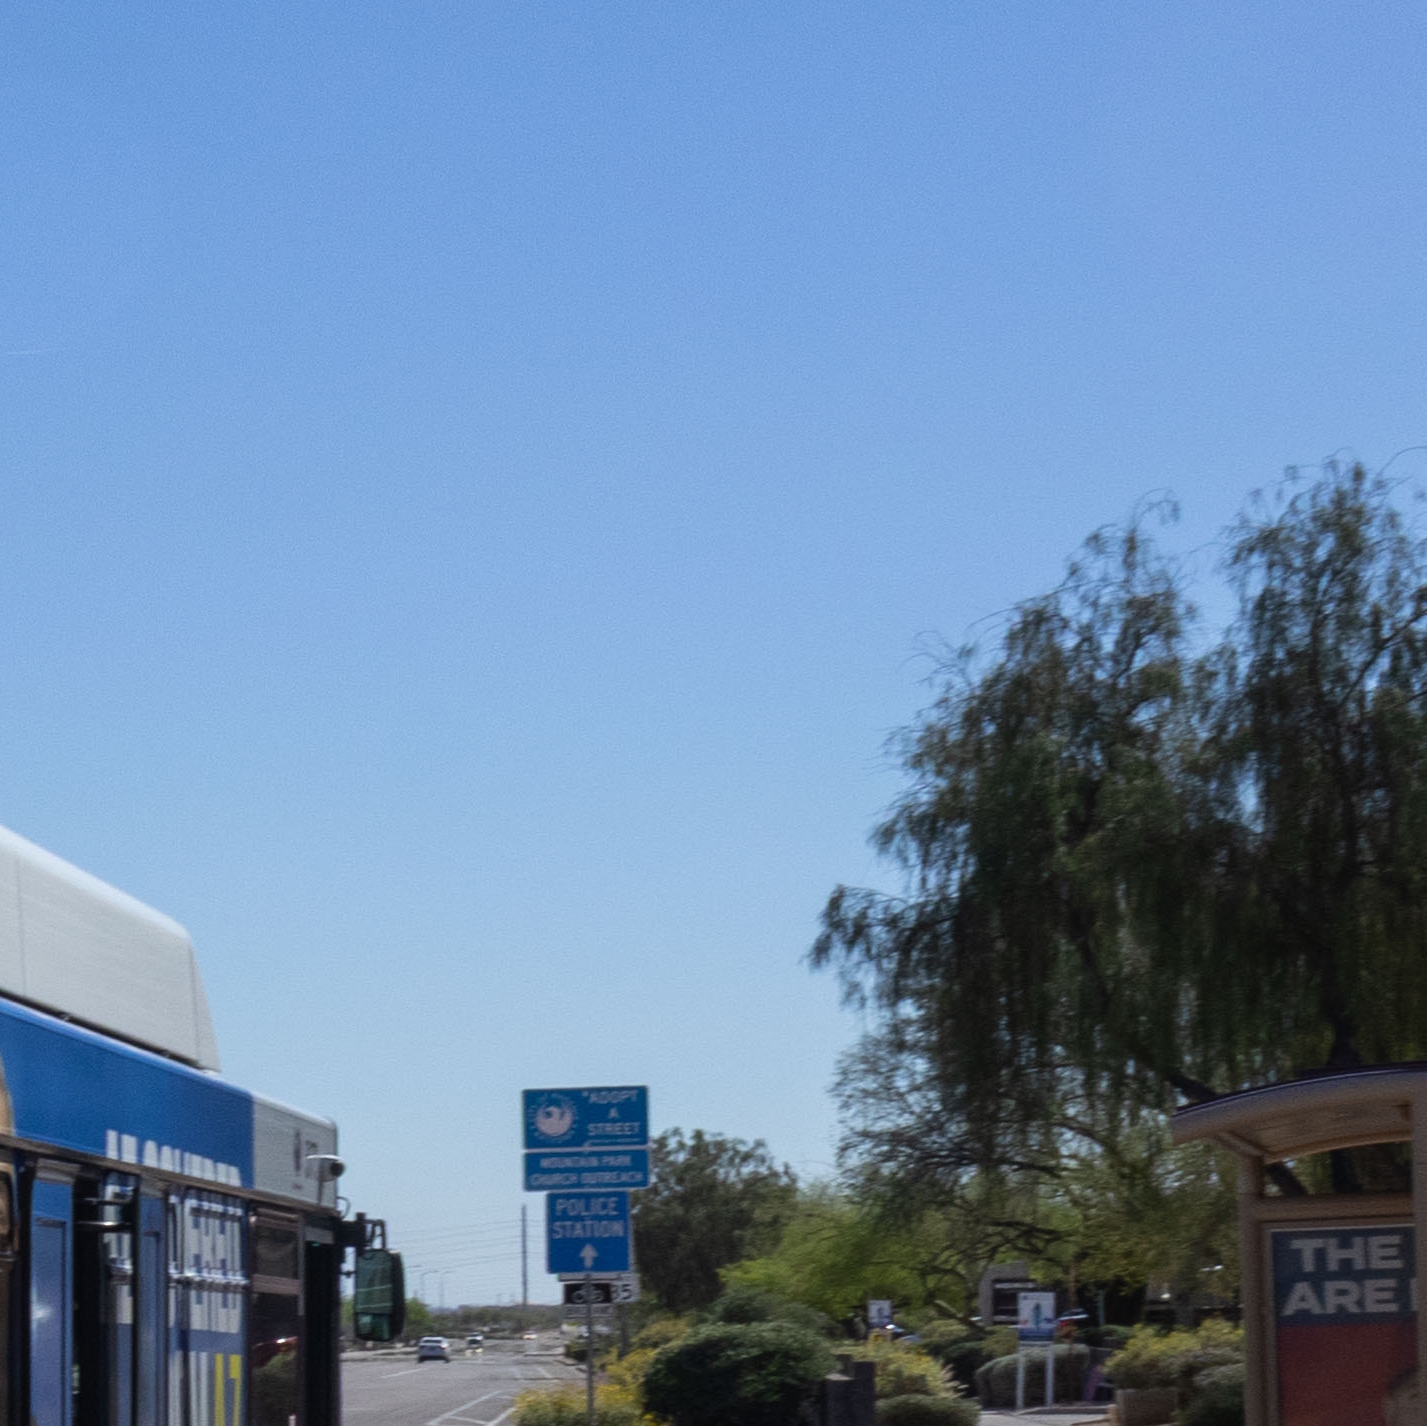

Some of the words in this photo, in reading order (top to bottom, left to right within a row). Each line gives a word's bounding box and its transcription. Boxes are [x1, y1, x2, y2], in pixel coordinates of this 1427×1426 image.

[608, 1106, 620, 1119] A
[555, 1197, 620, 1216] POLICE
[552, 1220, 625, 1239] STATION
[1290, 1235, 1404, 1272] THE
[1280, 1279, 1400, 1317] ARE
